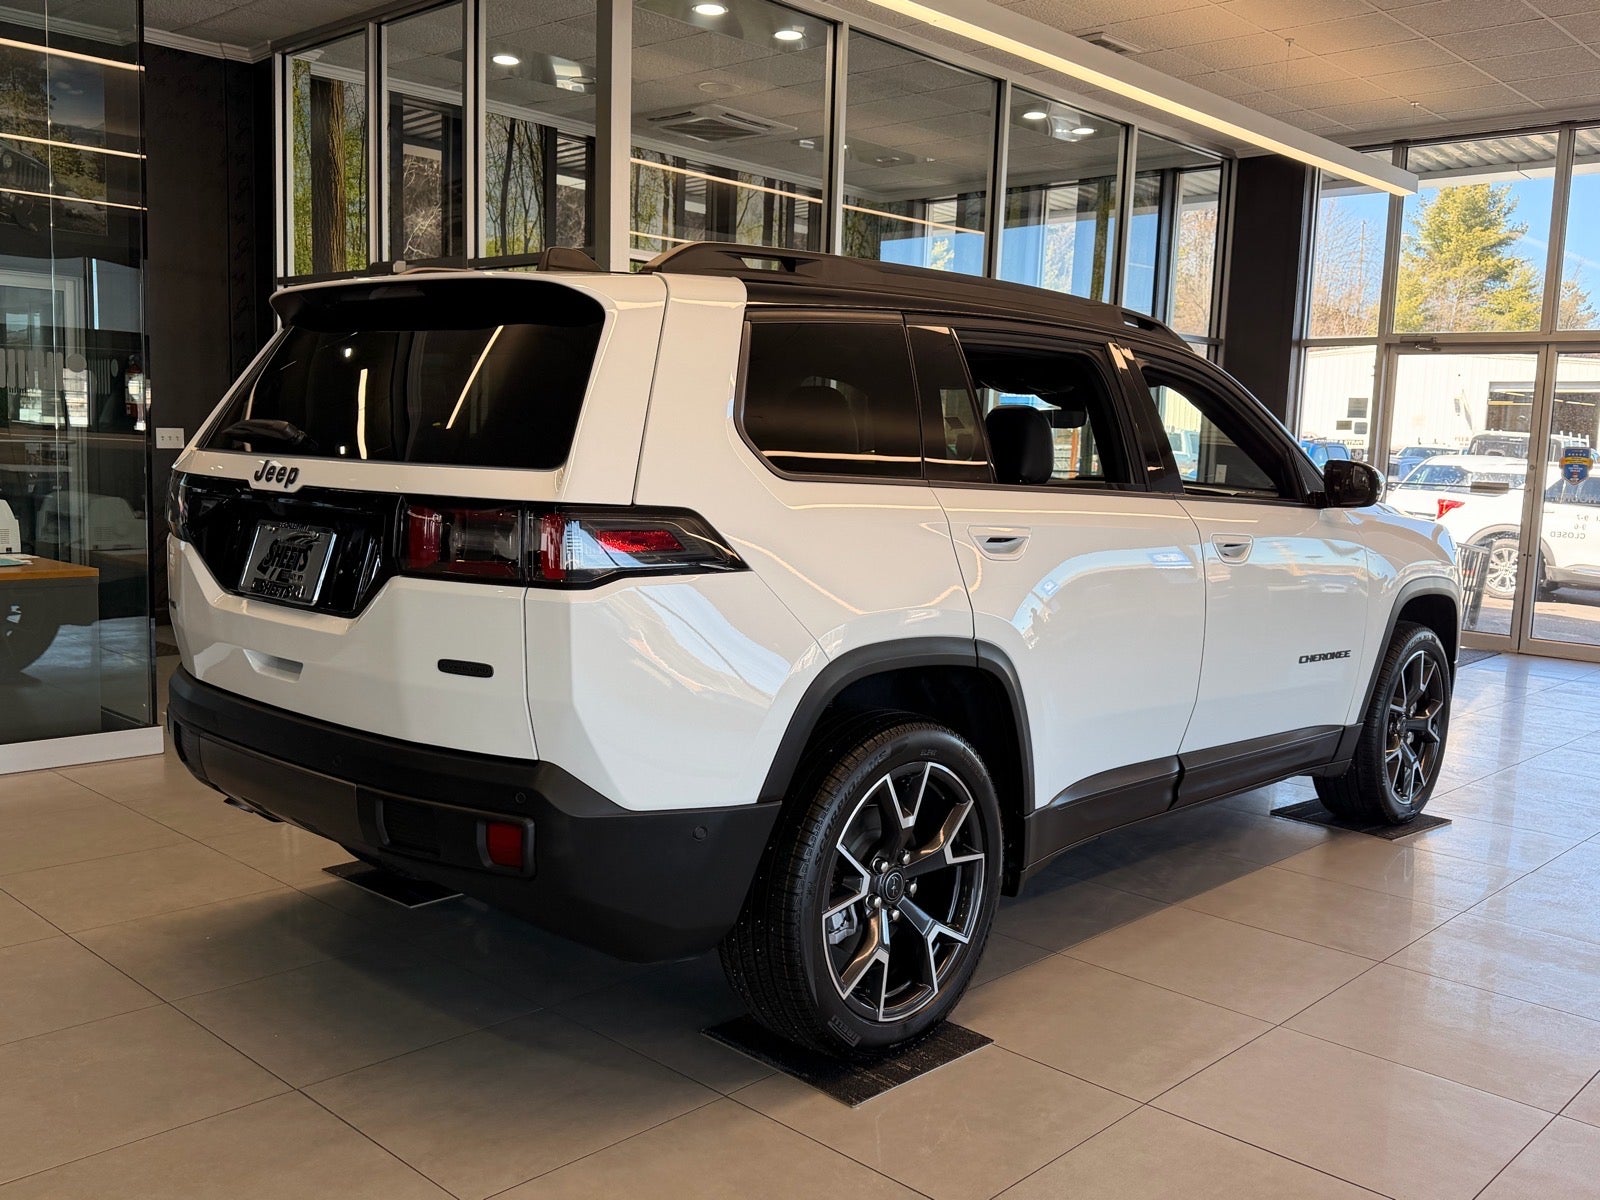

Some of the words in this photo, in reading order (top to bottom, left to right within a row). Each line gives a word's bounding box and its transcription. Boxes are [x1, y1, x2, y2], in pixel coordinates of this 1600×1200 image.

[254, 459, 299, 488] Jeep
[264, 539, 314, 572] SHEETS
[1299, 650, 1351, 664] CHEROKEE
